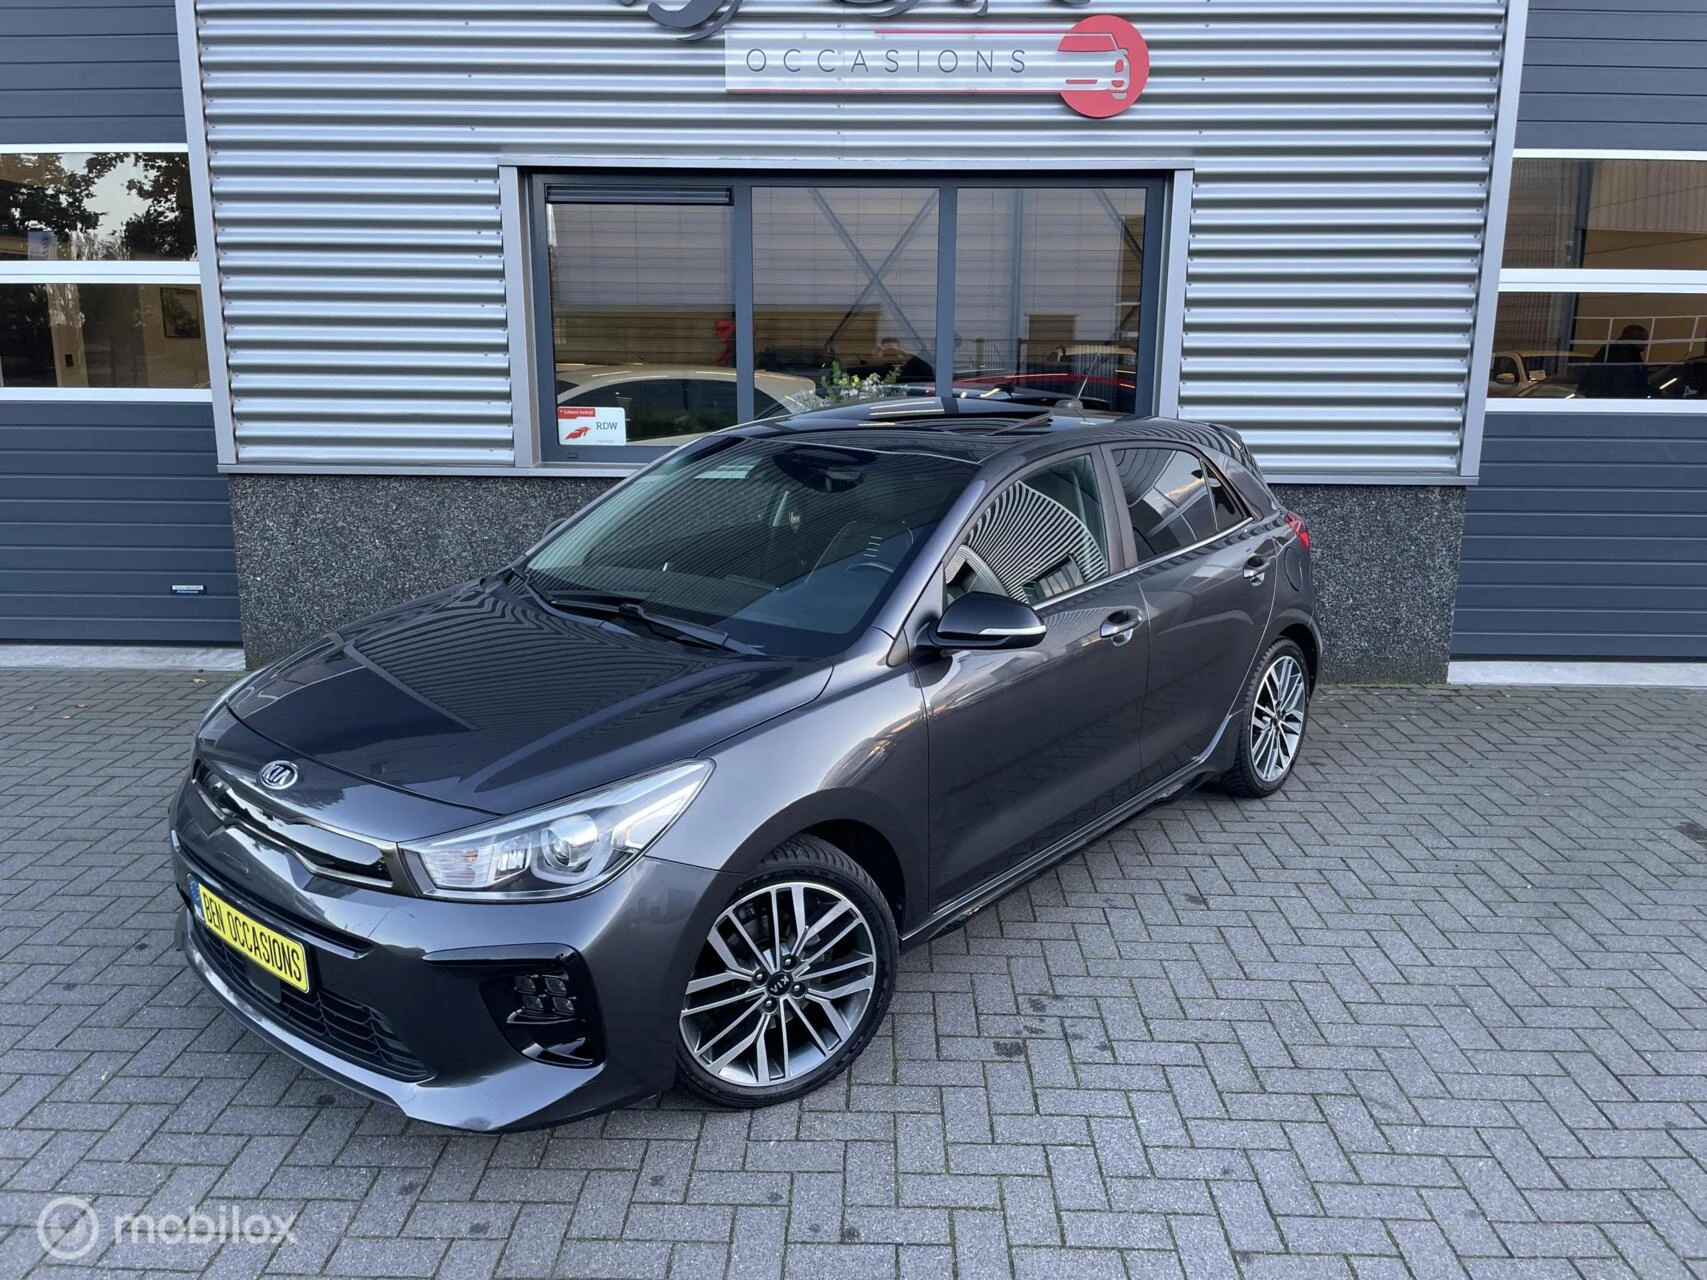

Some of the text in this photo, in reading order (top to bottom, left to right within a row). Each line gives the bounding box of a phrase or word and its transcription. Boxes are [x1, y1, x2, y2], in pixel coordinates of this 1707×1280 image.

[745, 47, 1027, 74] OCCASIONS
[596, 421, 617, 430] RDW
[262, 764, 291, 785] KIA
[203, 892, 302, 982] BEN OCCASIONS
[770, 975, 790, 993] KIA
